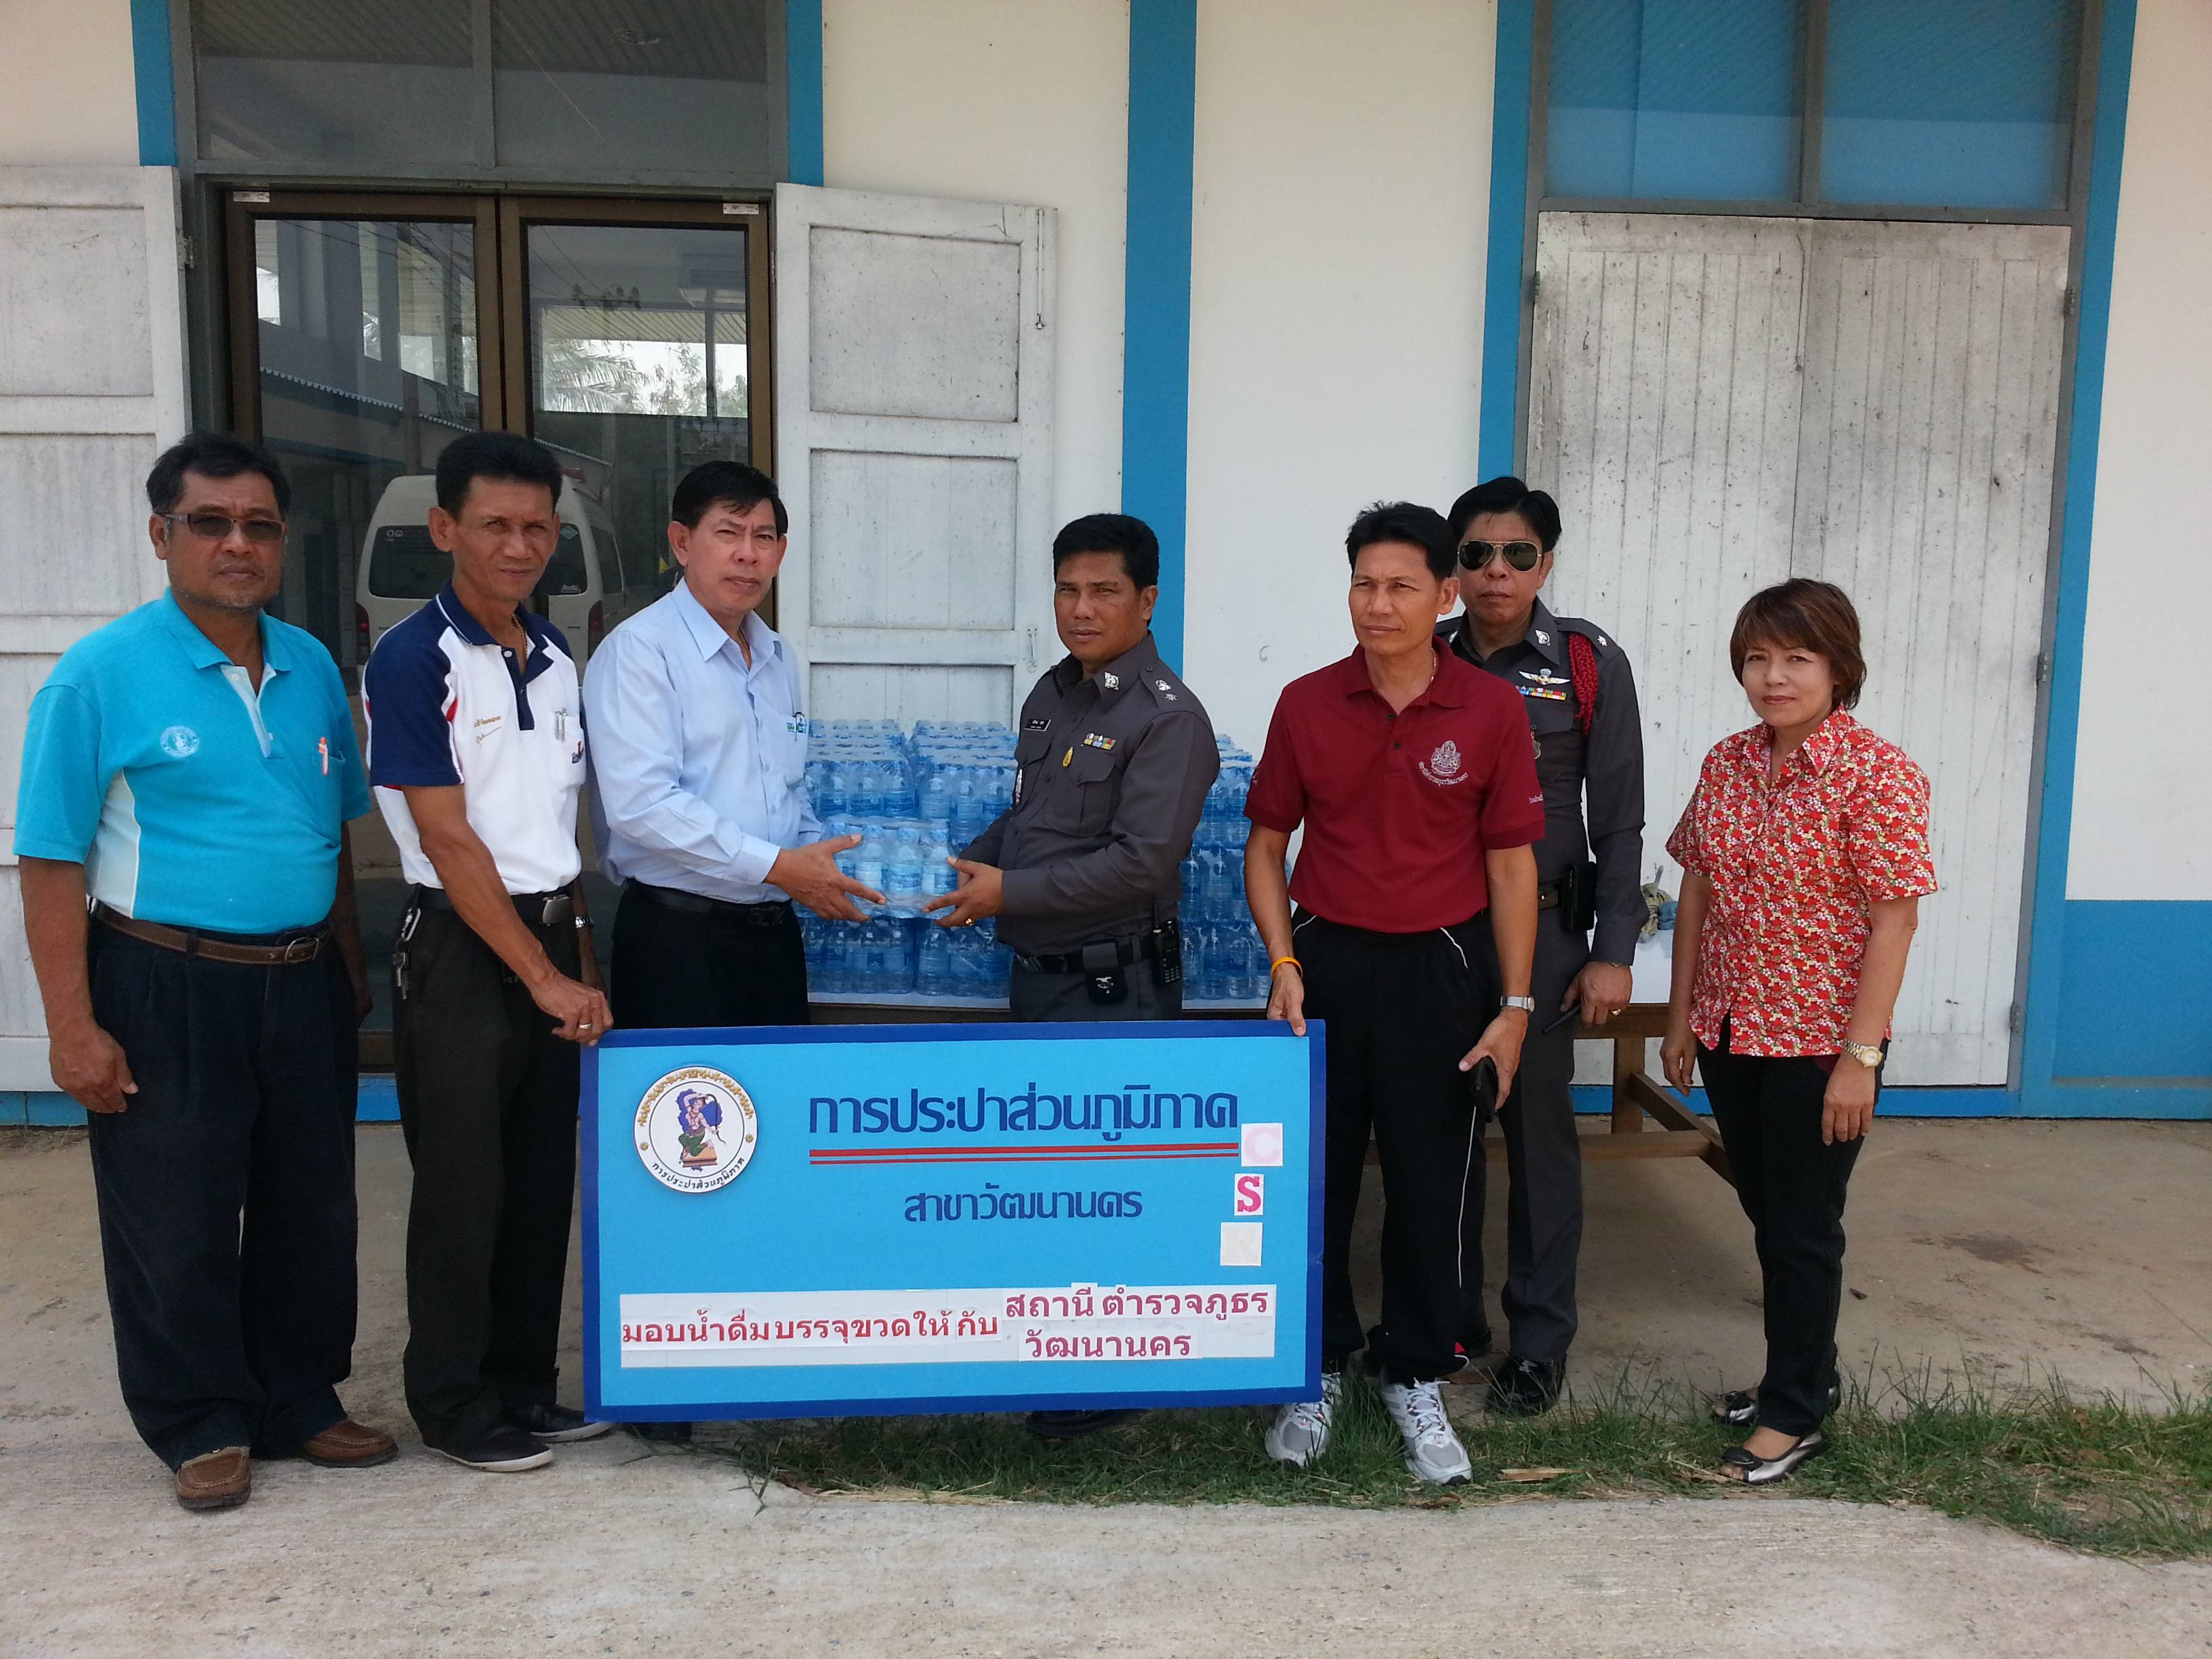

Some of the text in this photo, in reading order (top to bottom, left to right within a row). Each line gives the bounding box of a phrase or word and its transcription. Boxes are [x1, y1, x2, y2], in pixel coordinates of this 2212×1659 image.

[809, 1082, 1239, 1141] การประปาส่วนภูมิภาค
[904, 1182, 1143, 1222] สาขาวัฒนานคร
[1237, 1175, 1261, 1212] S
[1025, 1328, 1191, 1357] วัฒนานคร
